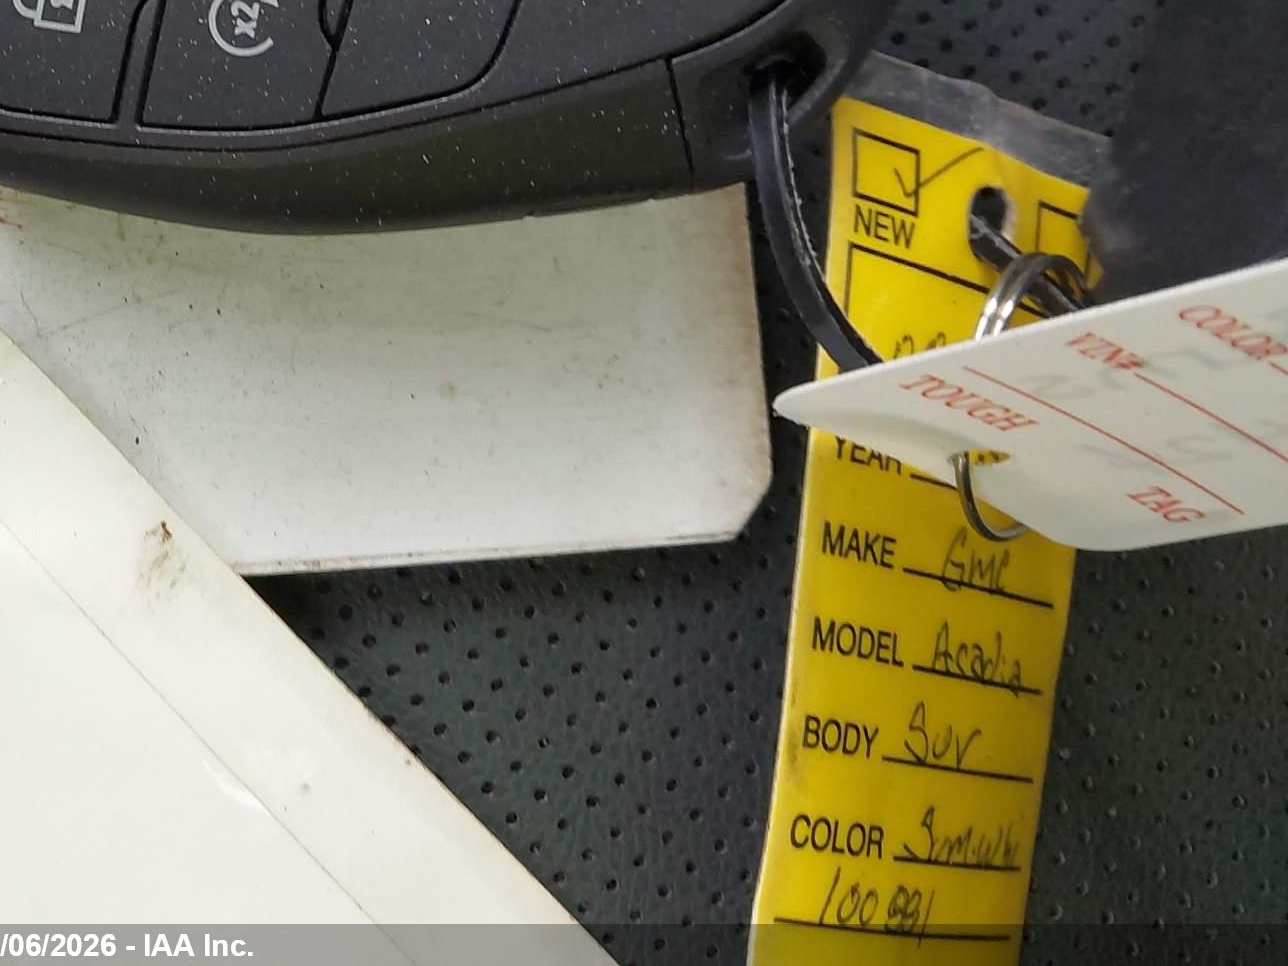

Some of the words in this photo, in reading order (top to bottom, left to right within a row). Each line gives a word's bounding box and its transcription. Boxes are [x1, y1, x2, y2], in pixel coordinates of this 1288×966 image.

[230, 0, 261, 39] x2
[853, 202, 915, 250] NEW
[898, 372, 1040, 432] TOUGH
[1126, 485, 1207, 522] TAG
[821, 521, 897, 570] MAKE
[812, 617, 904, 668] MODEL
[802, 715, 880, 760] BODY
[790, 814, 885, 860] COLOR
